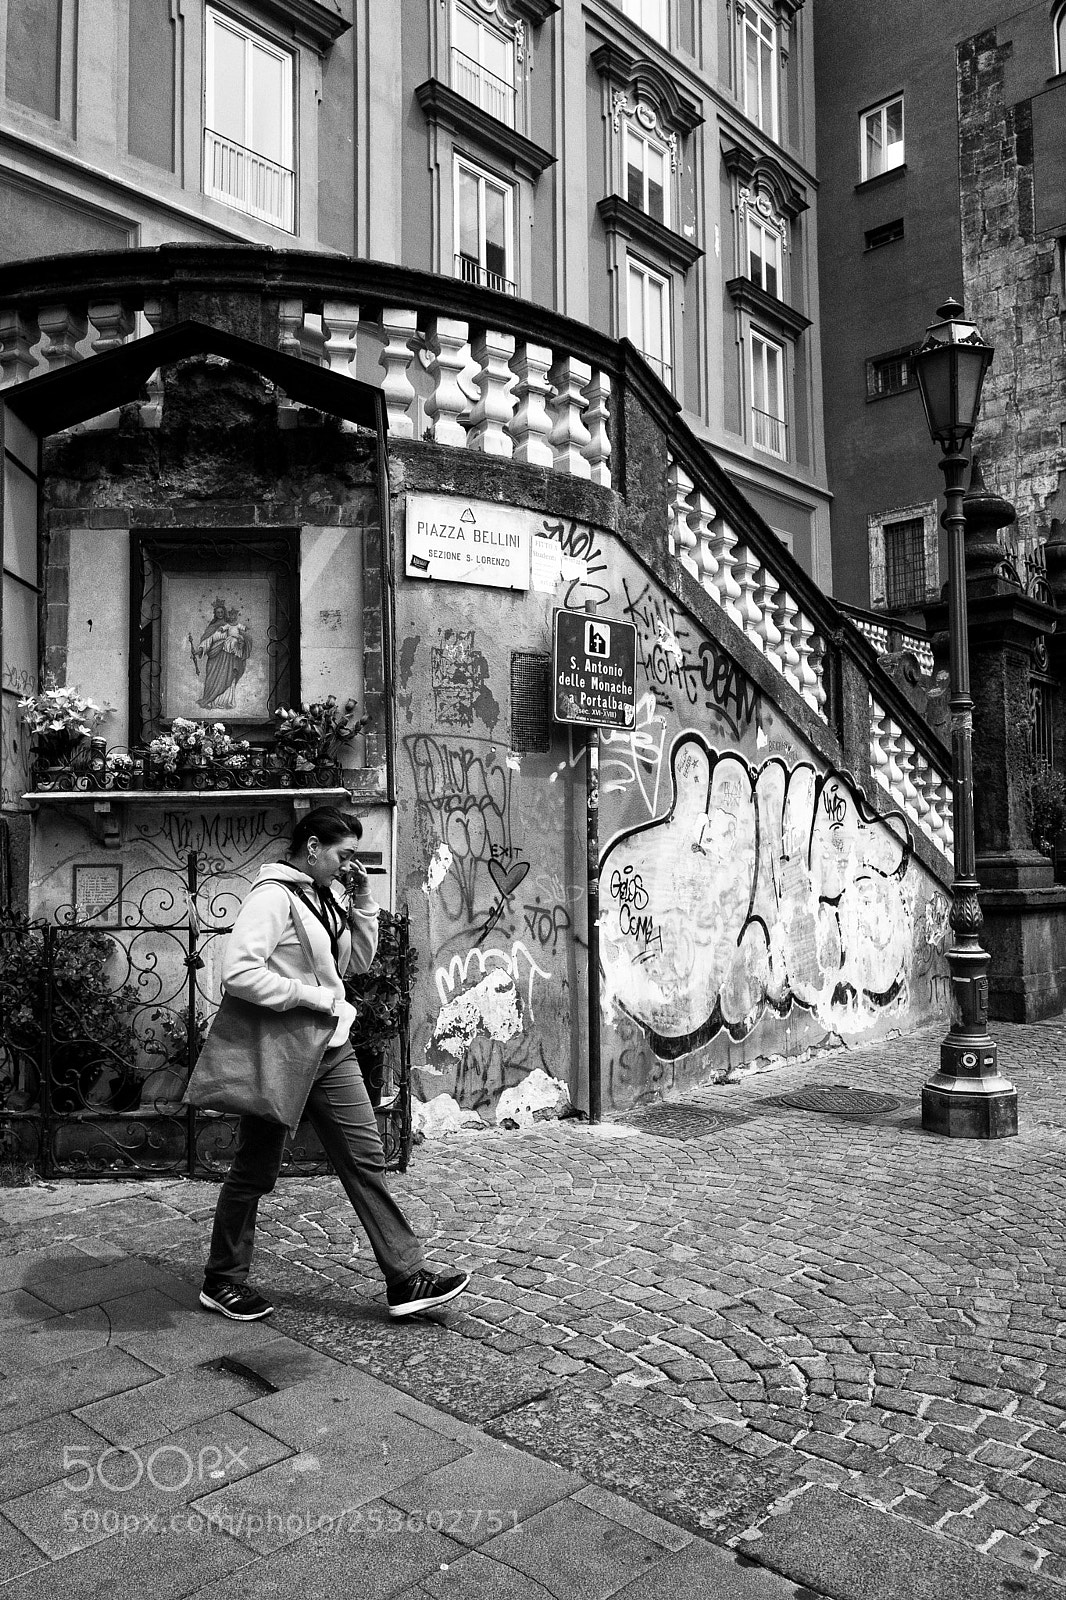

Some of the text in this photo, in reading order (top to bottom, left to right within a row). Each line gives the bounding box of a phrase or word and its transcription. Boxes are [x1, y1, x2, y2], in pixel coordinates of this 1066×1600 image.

[417, 521, 520, 548] PIAZZA BELLINI
[428, 549, 461, 561] SEZIONE
[476, 555, 511, 567] LORENZO
[570, 656, 623, 677] S. Antonio
[558, 671, 633, 695] delle Monache
[568, 691, 623, 711] a Portalba
[199, 811, 267, 862] MARIA
[490, 843, 523, 859] EXIT
